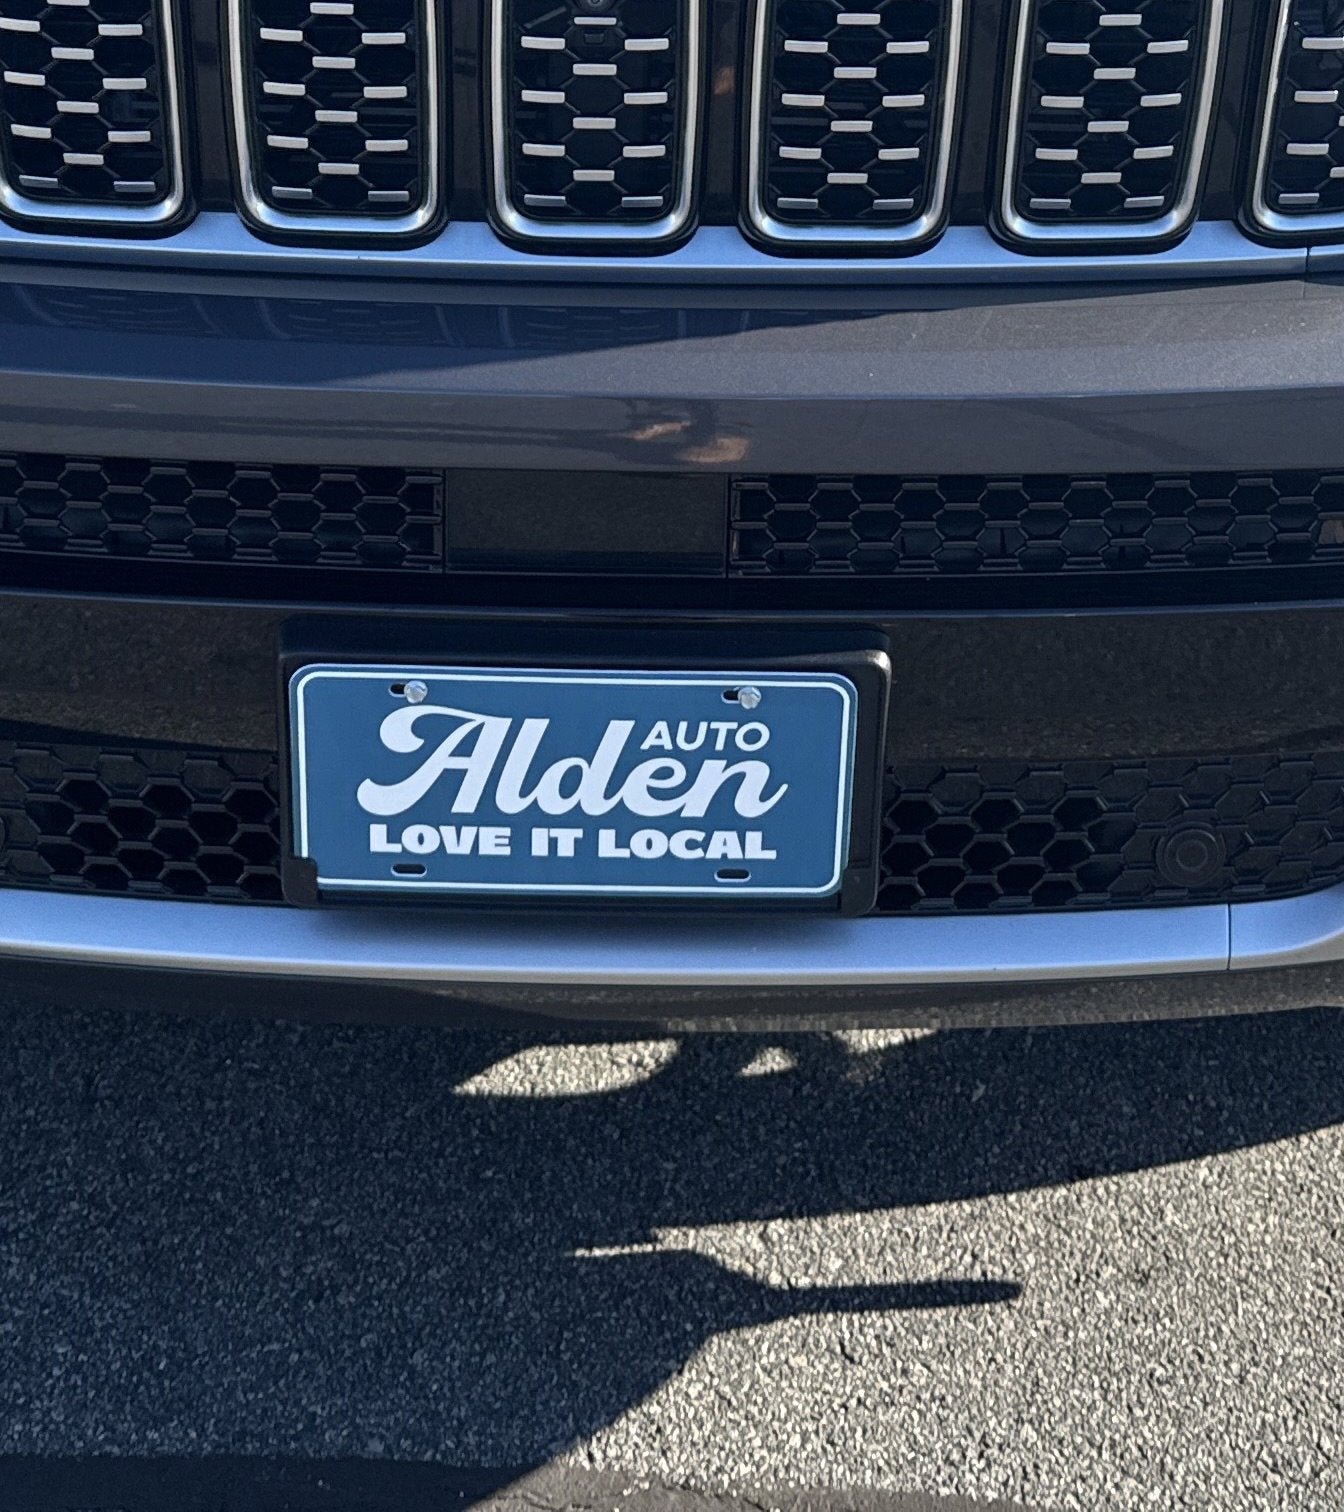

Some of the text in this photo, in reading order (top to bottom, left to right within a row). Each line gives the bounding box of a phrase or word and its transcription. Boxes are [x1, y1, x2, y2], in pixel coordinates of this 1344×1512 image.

[640, 720, 771, 752] AUTO
[356, 704, 789, 818] Alden
[369, 823, 777, 860] LOVE IT LOCAL
